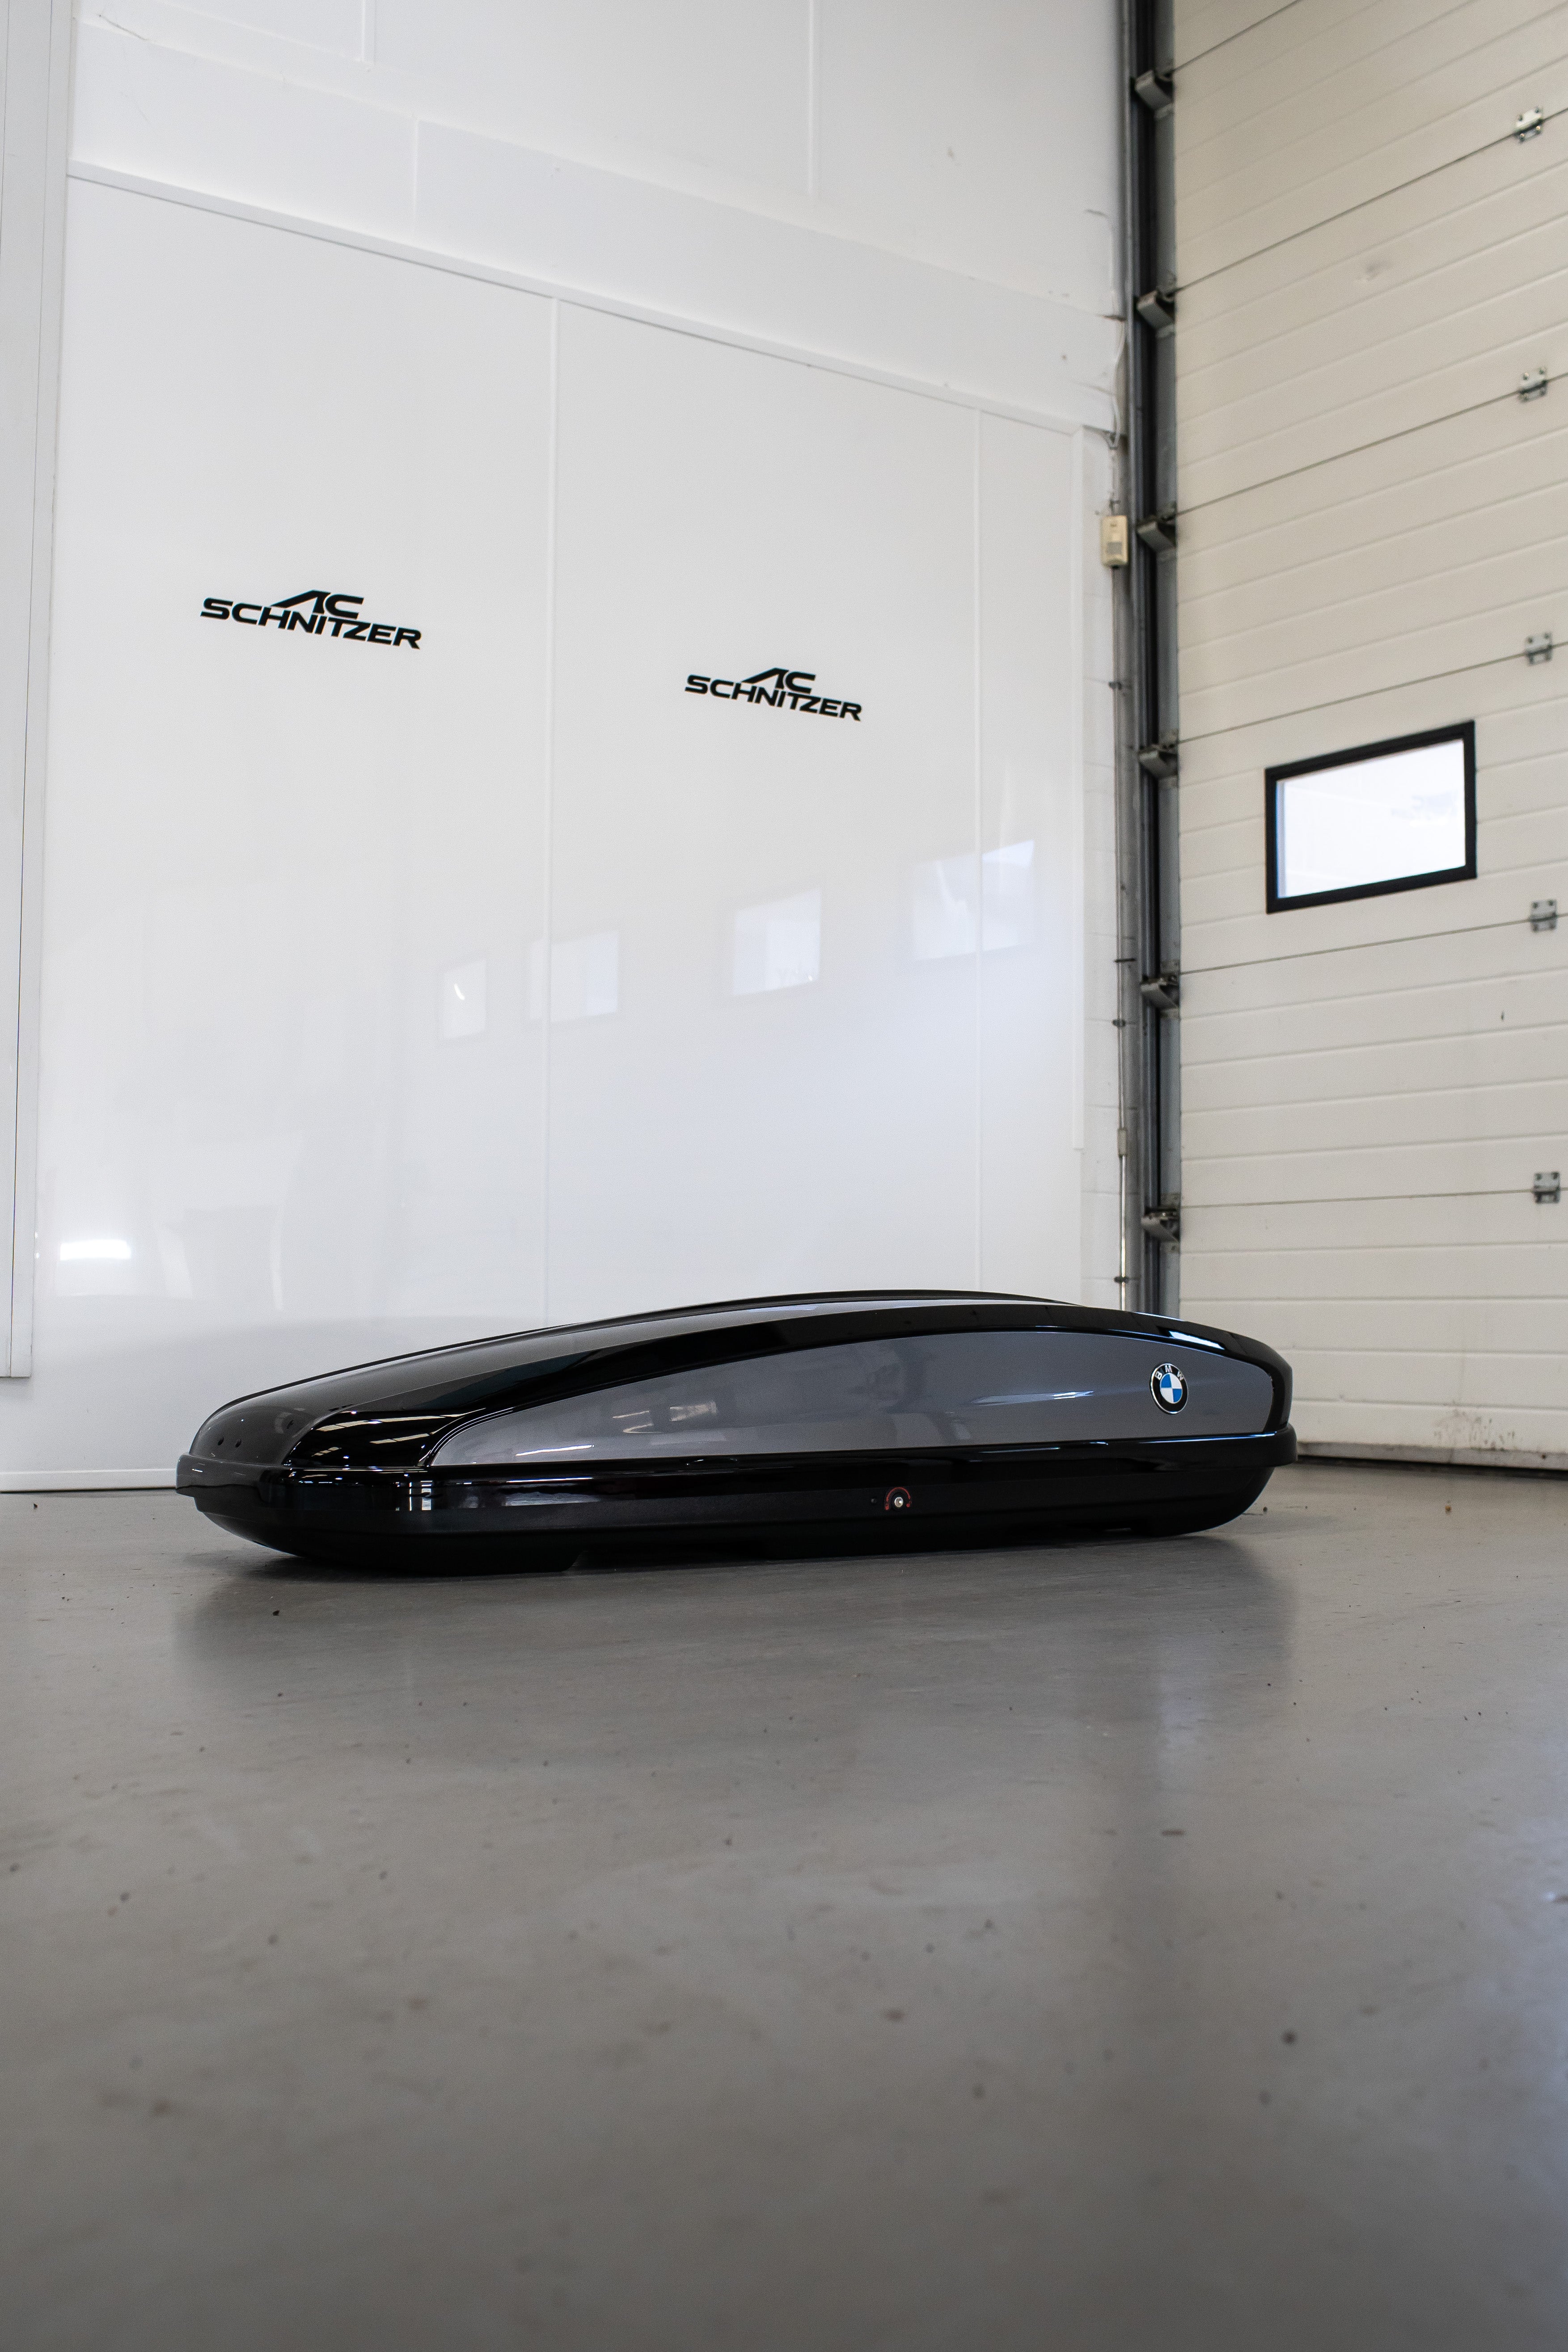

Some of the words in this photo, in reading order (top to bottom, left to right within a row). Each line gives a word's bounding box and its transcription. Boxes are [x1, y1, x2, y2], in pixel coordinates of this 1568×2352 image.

[270, 590, 364, 620] AC
[200, 598, 421, 650] SCHNITZER
[741, 668, 816, 695] AC
[685, 675, 862, 721] SCHNITZER
[1154, 1365, 1184, 1381] BMW
